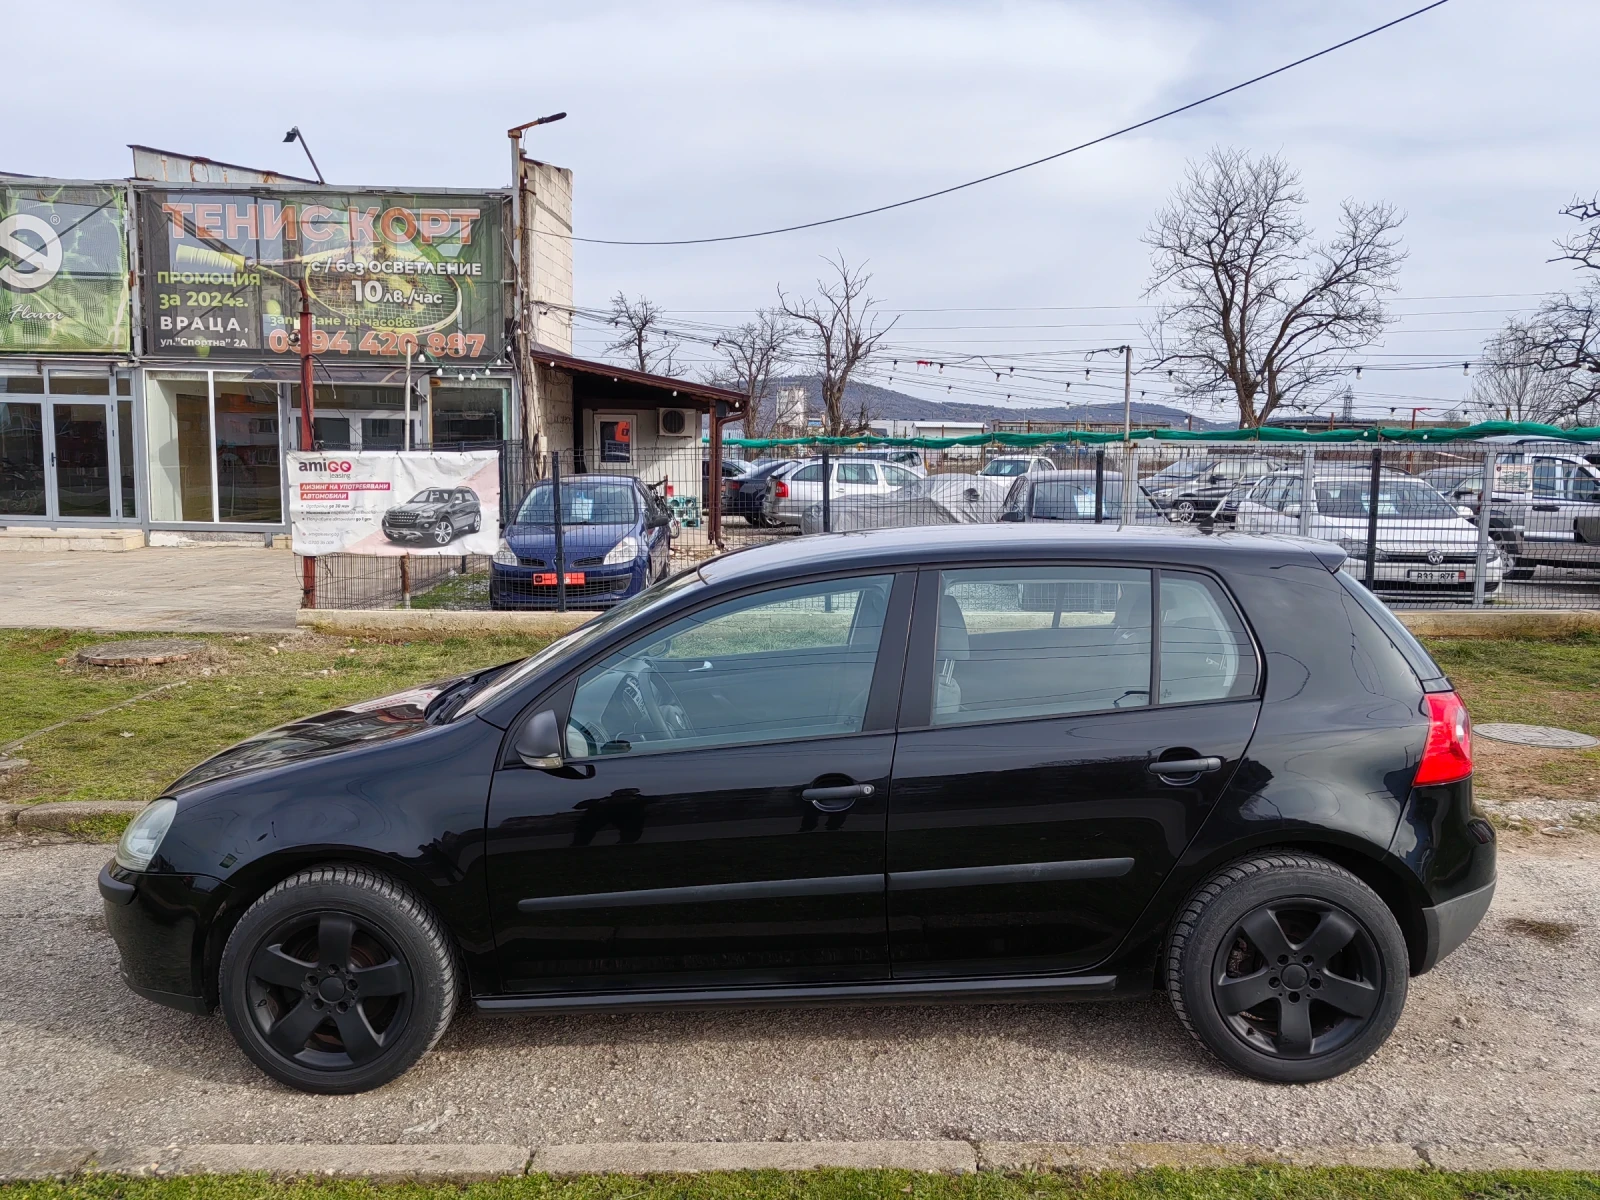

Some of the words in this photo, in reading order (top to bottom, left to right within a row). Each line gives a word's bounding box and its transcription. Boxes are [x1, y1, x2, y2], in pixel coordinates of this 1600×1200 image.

[162, 203, 333, 242] ТЕНИС
[348, 207, 480, 244] КОРТ
[336, 260, 365, 275] без
[368, 261, 482, 276] ОСВЕТЛЕНИЕ
[157, 272, 260, 287] ПРОМОЦИЯ
[159, 294, 181, 309] за
[186, 292, 249, 308] 2024г.
[8, 303, 65, 323] Flavor
[160, 317, 249, 333] ВРАЦА,
[345, 317, 361, 327] на
[365, 316, 415, 327] часове:
[269, 329, 352, 354] 094
[359, 331, 419, 356] 420
[427, 333, 486, 358] 887
[339, 483, 389, 491] УПОТРЕБЯВАНИ
